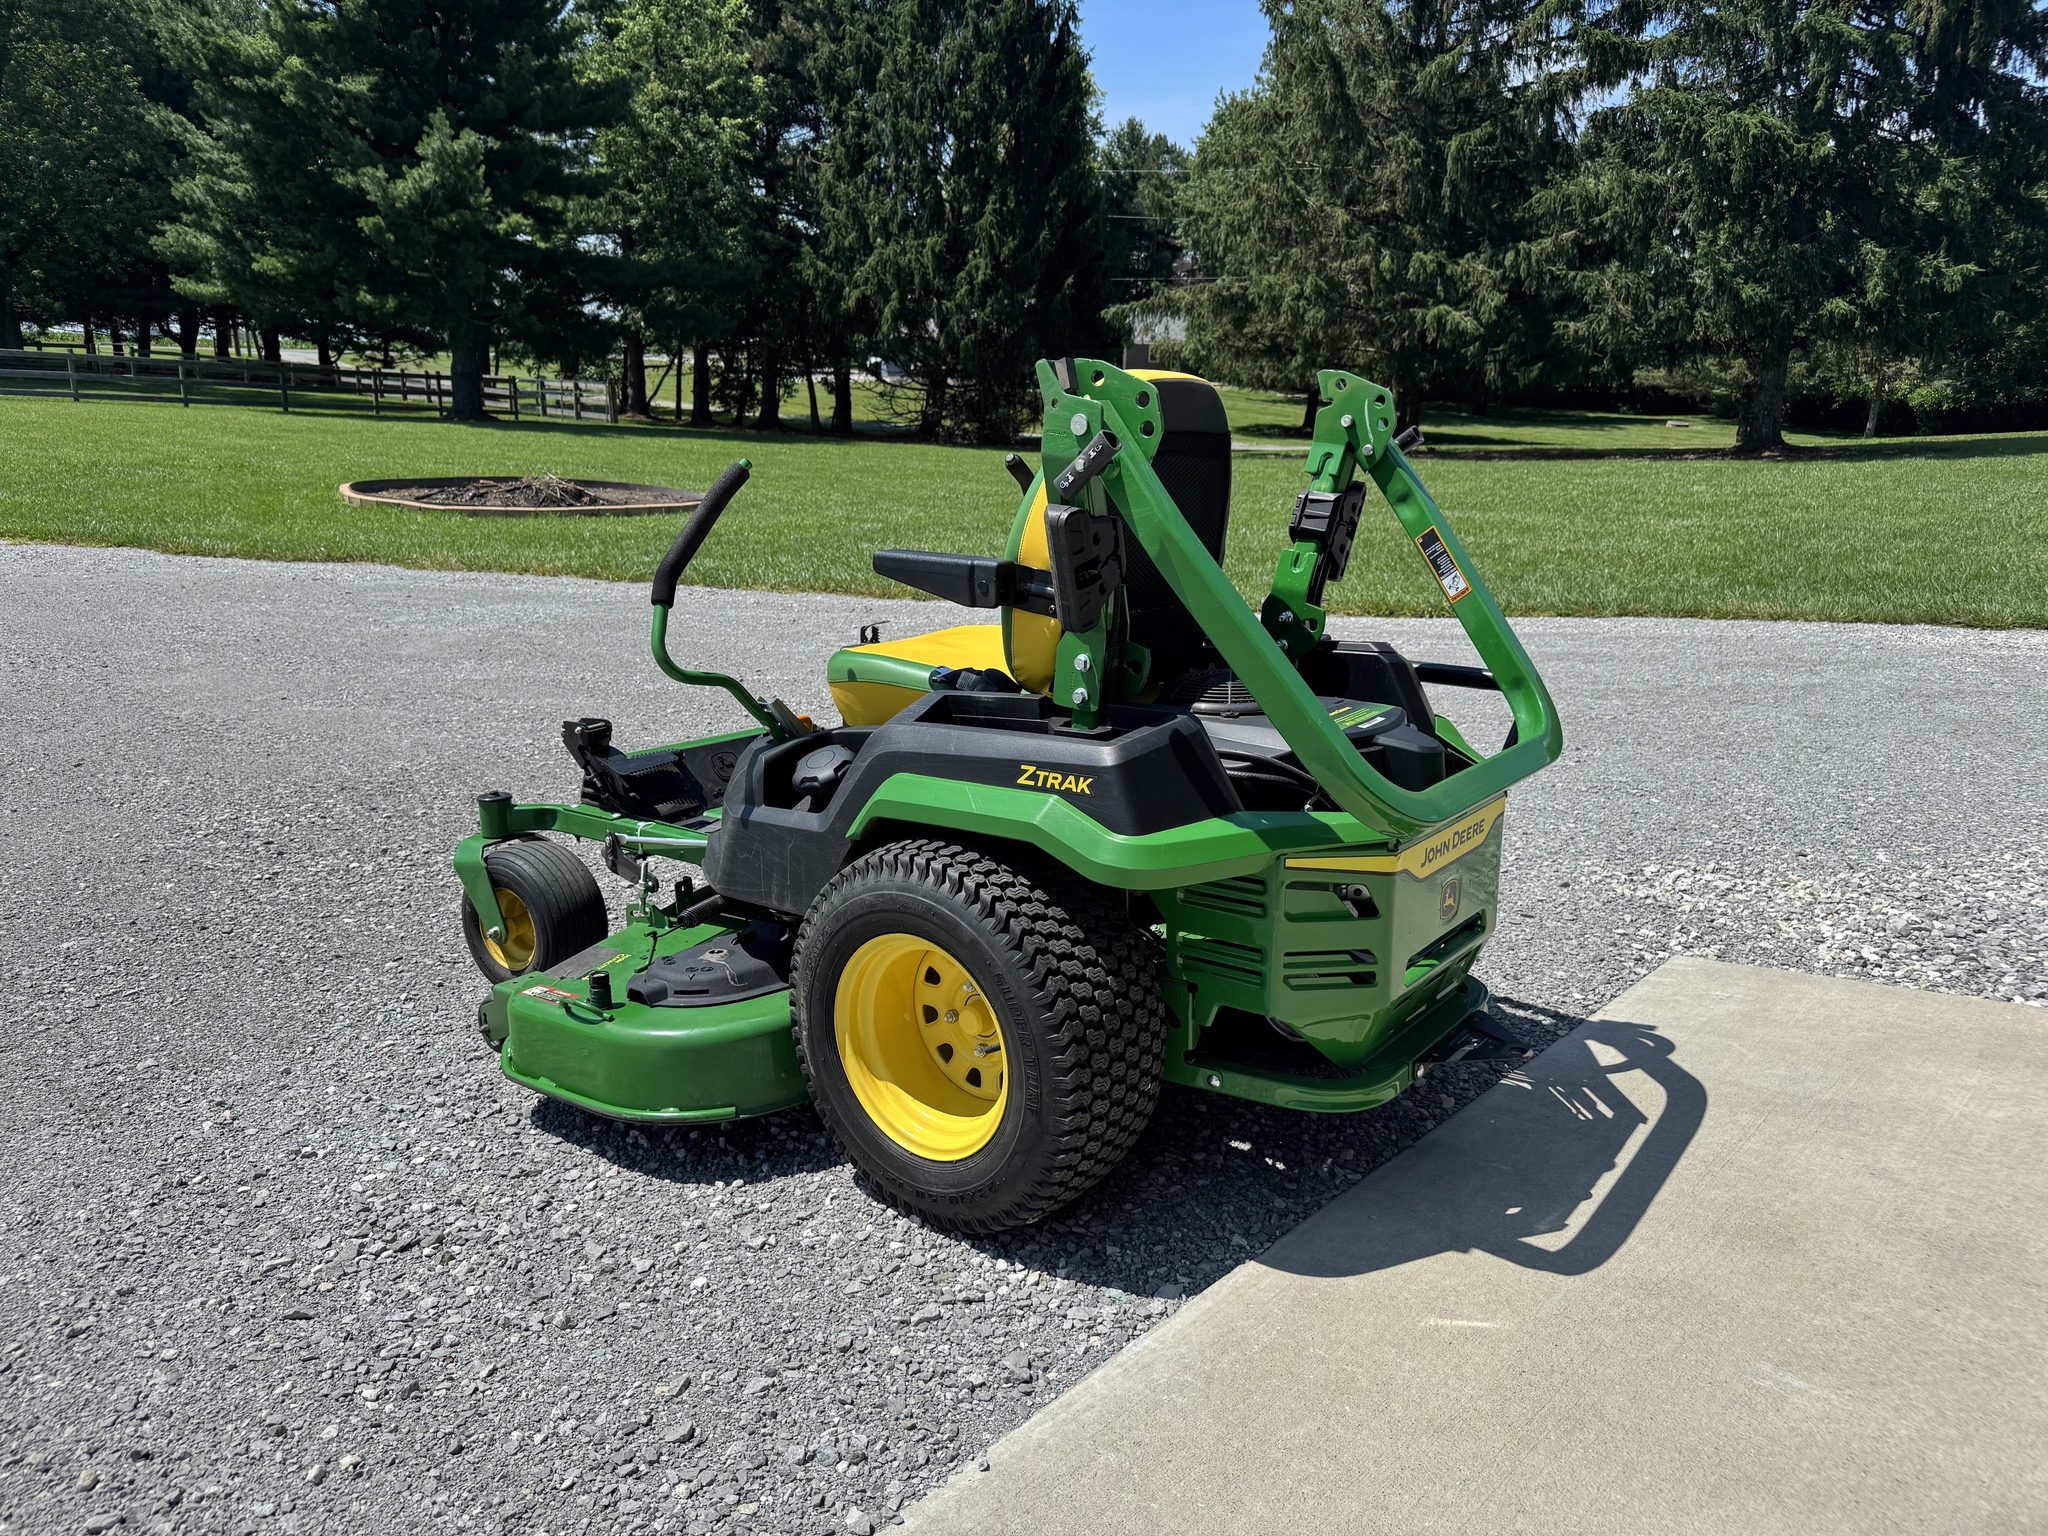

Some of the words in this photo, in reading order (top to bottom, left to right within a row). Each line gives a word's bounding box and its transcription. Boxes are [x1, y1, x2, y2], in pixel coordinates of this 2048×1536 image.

[1017, 764, 1094, 795] ZTRAK
[1420, 838, 1451, 868] JOHN
[1452, 818, 1485, 850] DEERE
[994, 971, 1032, 1047] SUPER
[1024, 1056, 1039, 1116] TURF
